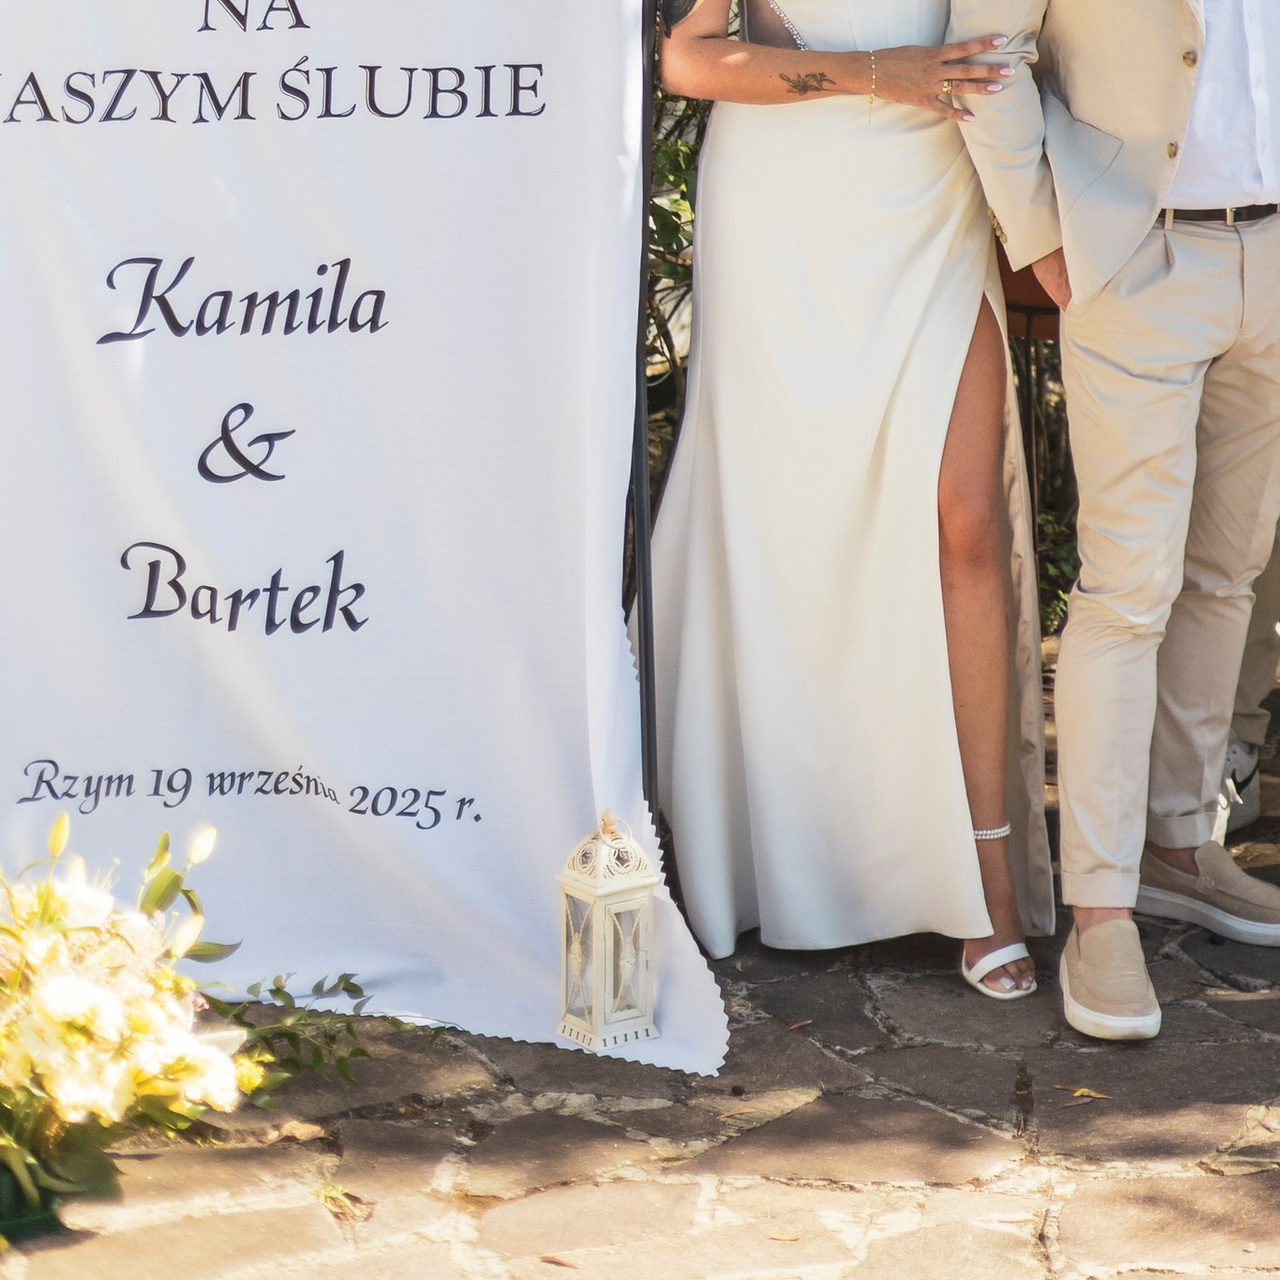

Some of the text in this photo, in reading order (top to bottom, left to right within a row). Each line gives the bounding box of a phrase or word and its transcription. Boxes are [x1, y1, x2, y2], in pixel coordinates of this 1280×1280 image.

[0, 56, 546, 124] ASZYM ŚLUBIE
[96, 257, 389, 344] Kamila
[198, 403, 296, 483] &
[120, 542, 369, 635] Bartek
[17, 760, 482, 829] Rzym 19 września 2025 r.
